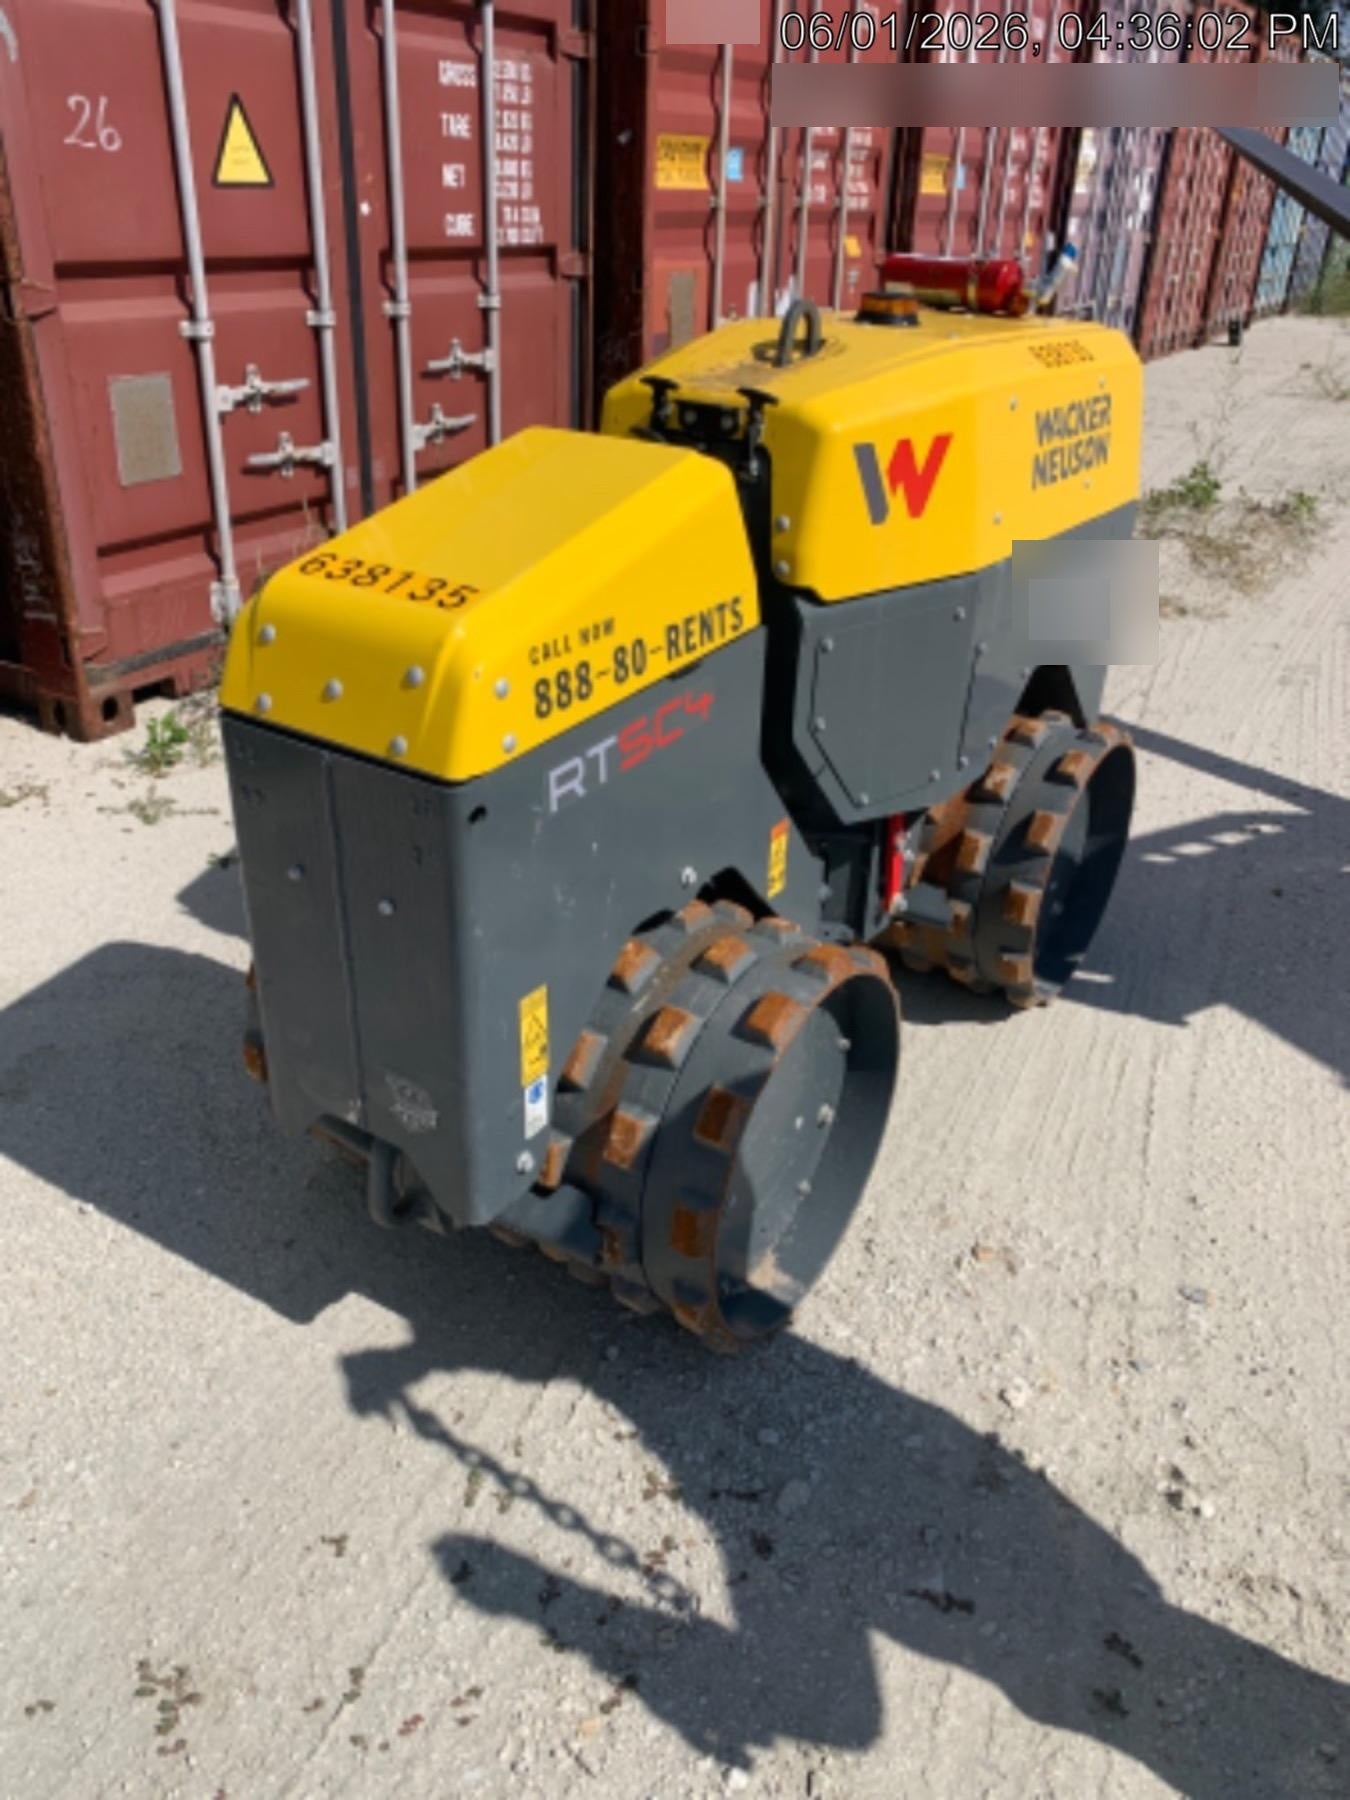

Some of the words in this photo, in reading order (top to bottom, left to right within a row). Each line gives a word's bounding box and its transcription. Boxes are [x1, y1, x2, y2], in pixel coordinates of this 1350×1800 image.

[63, 94, 121, 152] 26
[1035, 393, 1112, 446] WACKER
[1031, 433, 1111, 491] NEUSON
[299, 552, 480, 609] 638135
[529, 635, 572, 665] CALL
[579, 617, 616, 646] NOW
[534, 596, 745, 719] 888-80-RENTS
